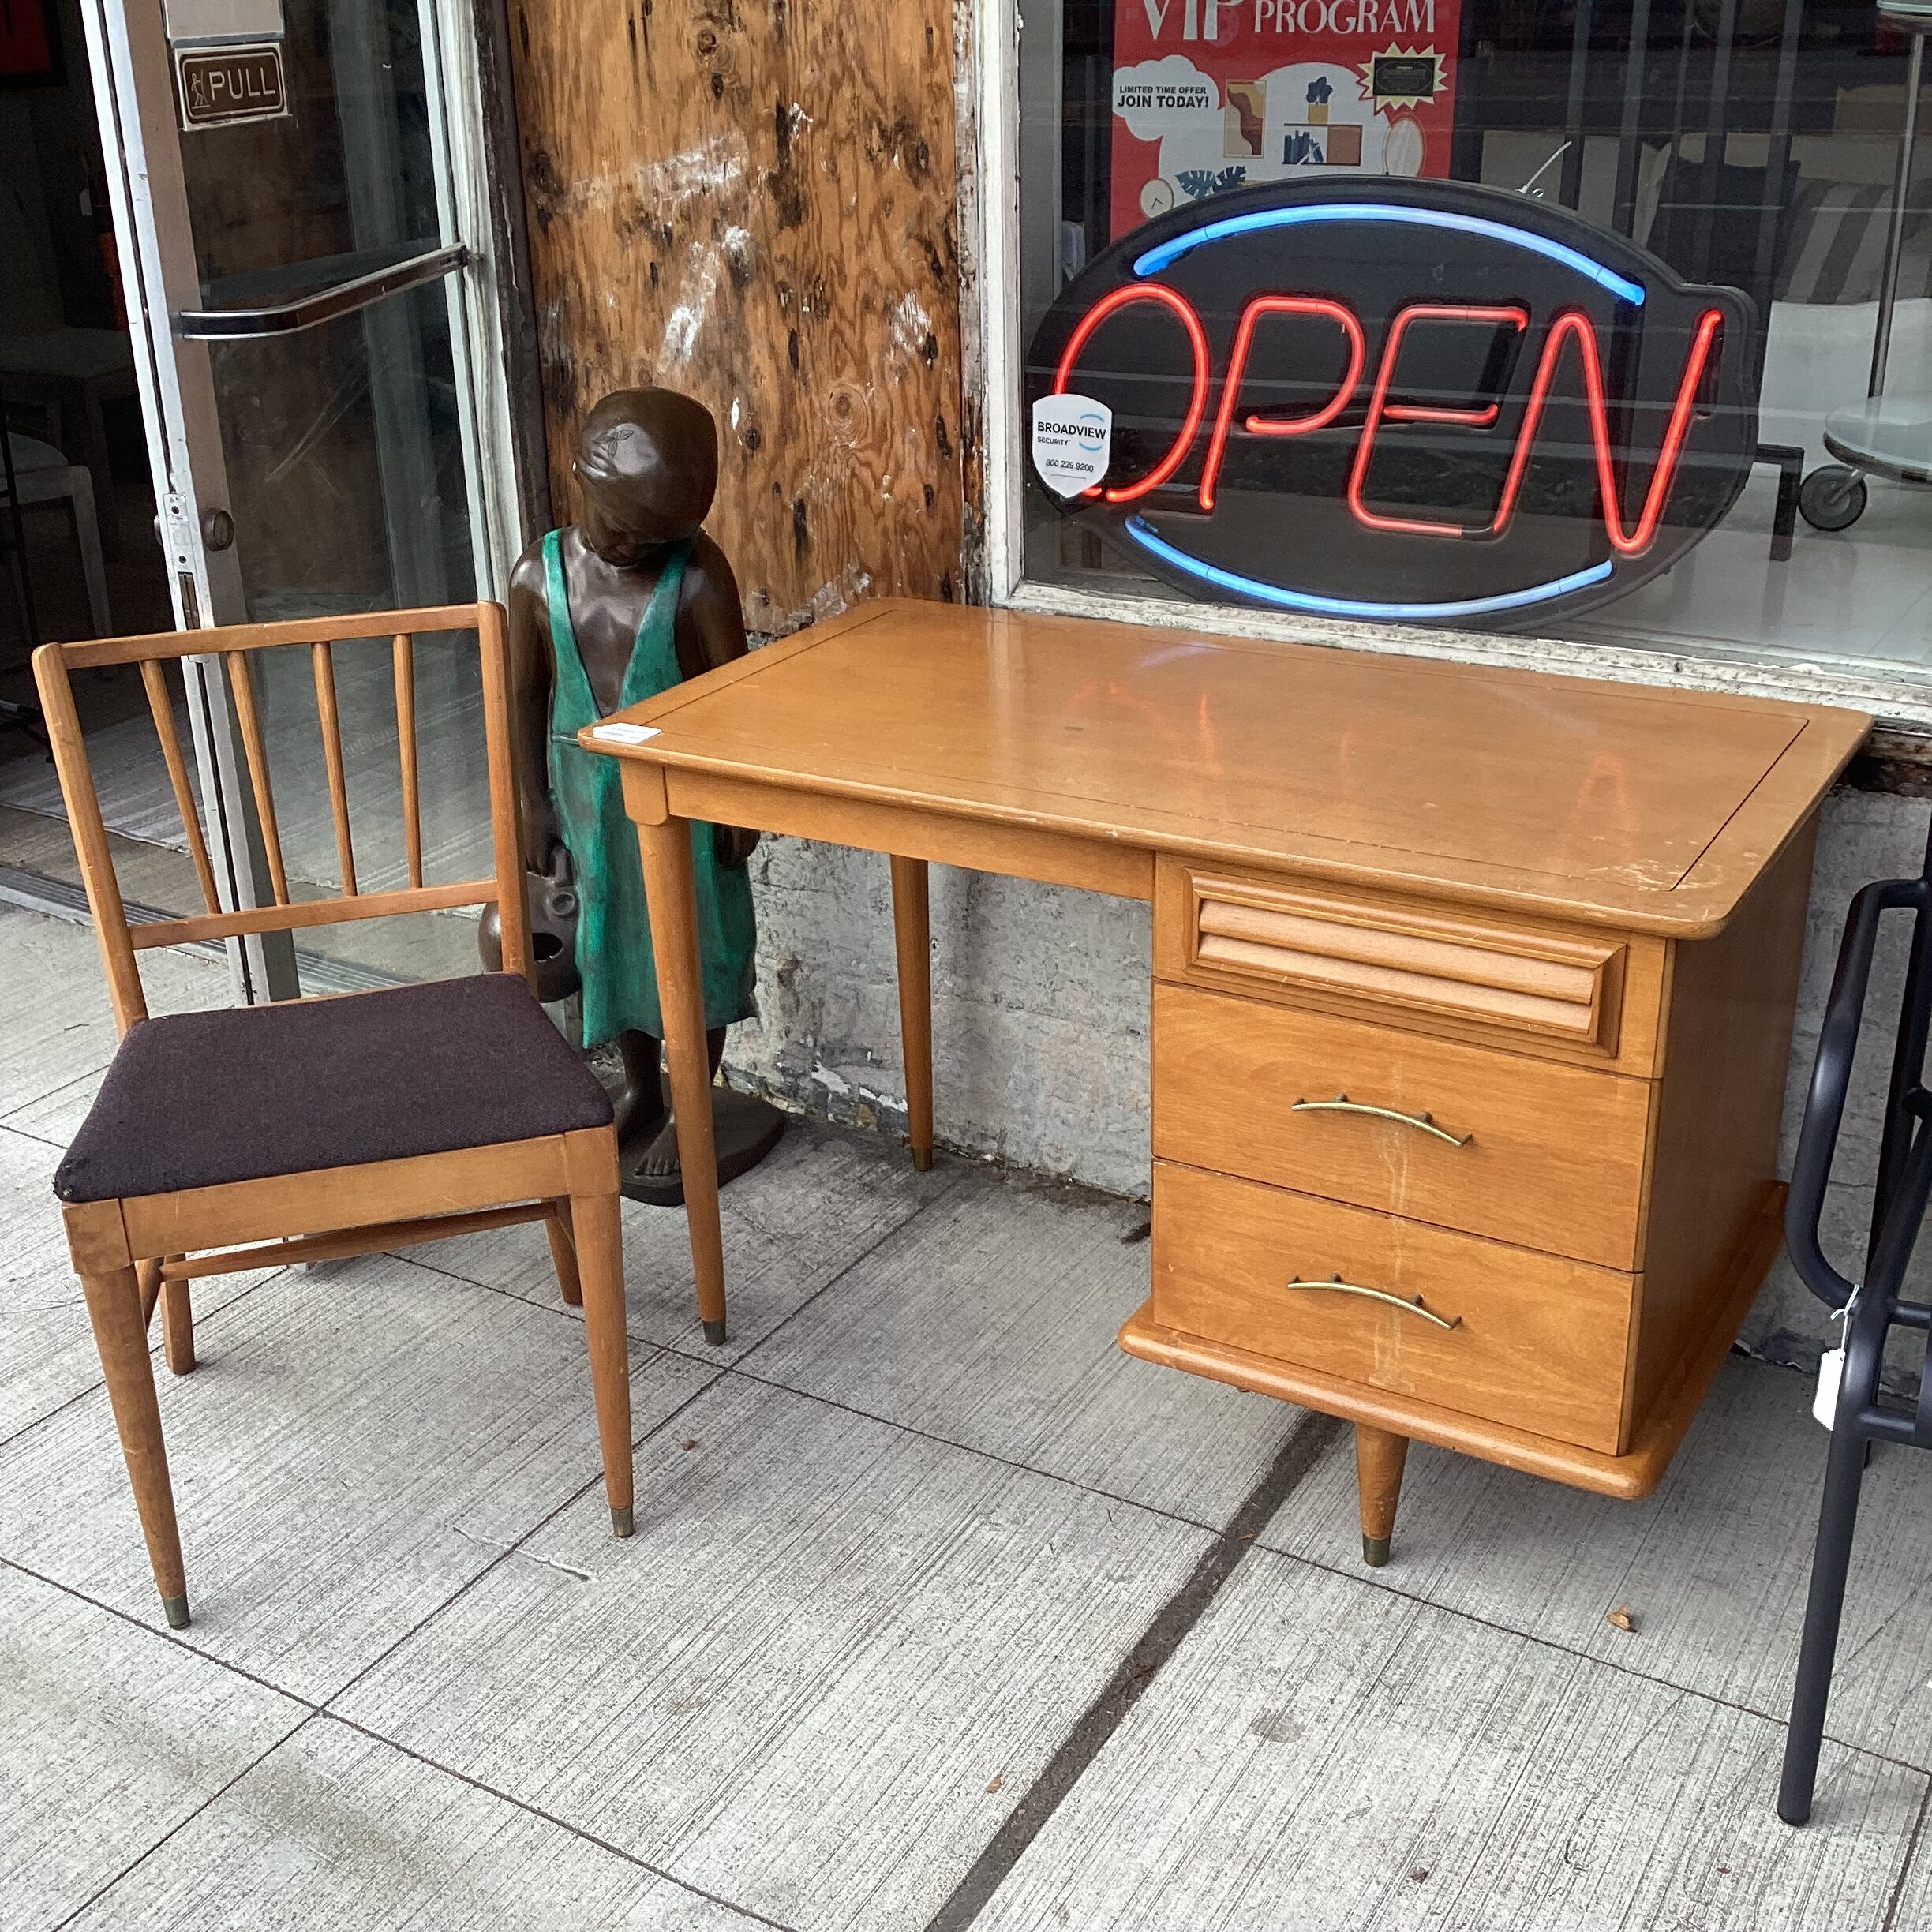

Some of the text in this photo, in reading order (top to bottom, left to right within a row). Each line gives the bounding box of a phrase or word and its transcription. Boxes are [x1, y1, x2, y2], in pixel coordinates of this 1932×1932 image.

[1254, 0, 1435, 33] PROGRAM
[208, 67, 276, 102] PULL
[1118, 95, 1210, 108] JOIN TODAY!
[1037, 421, 1106, 440] BROADVIEW
[1052, 283, 1723, 553] OPEN
[1037, 436, 1069, 446] SECURITY
